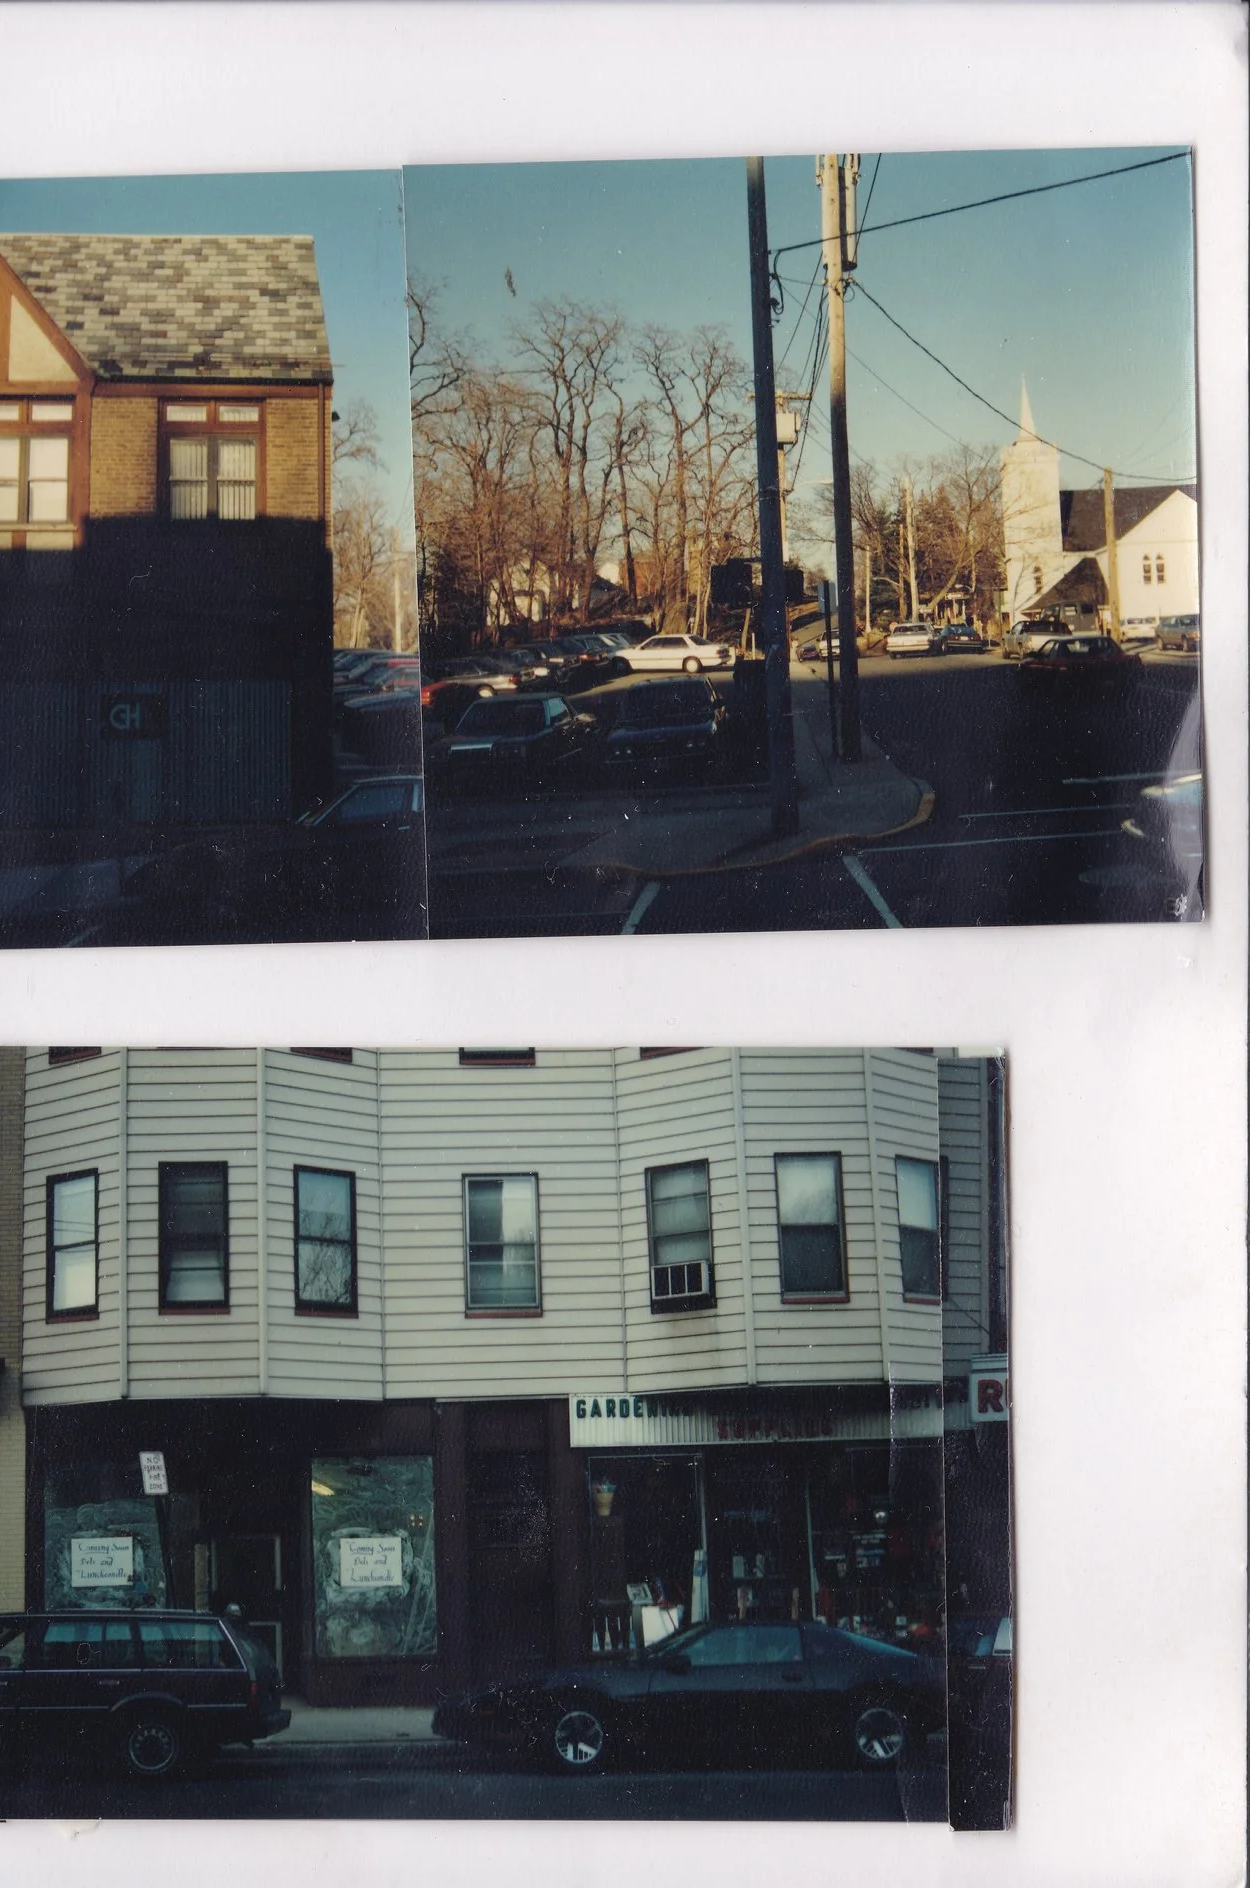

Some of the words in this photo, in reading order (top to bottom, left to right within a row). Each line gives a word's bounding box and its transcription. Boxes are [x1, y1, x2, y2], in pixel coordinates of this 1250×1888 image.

[977, 1378, 1009, 1415] R
[78, 1543, 110, 1555] Coming
[349, 1543, 375, 1555] Coming
[100, 1556, 114, 1566] and
[373, 1554, 388, 1566] and
